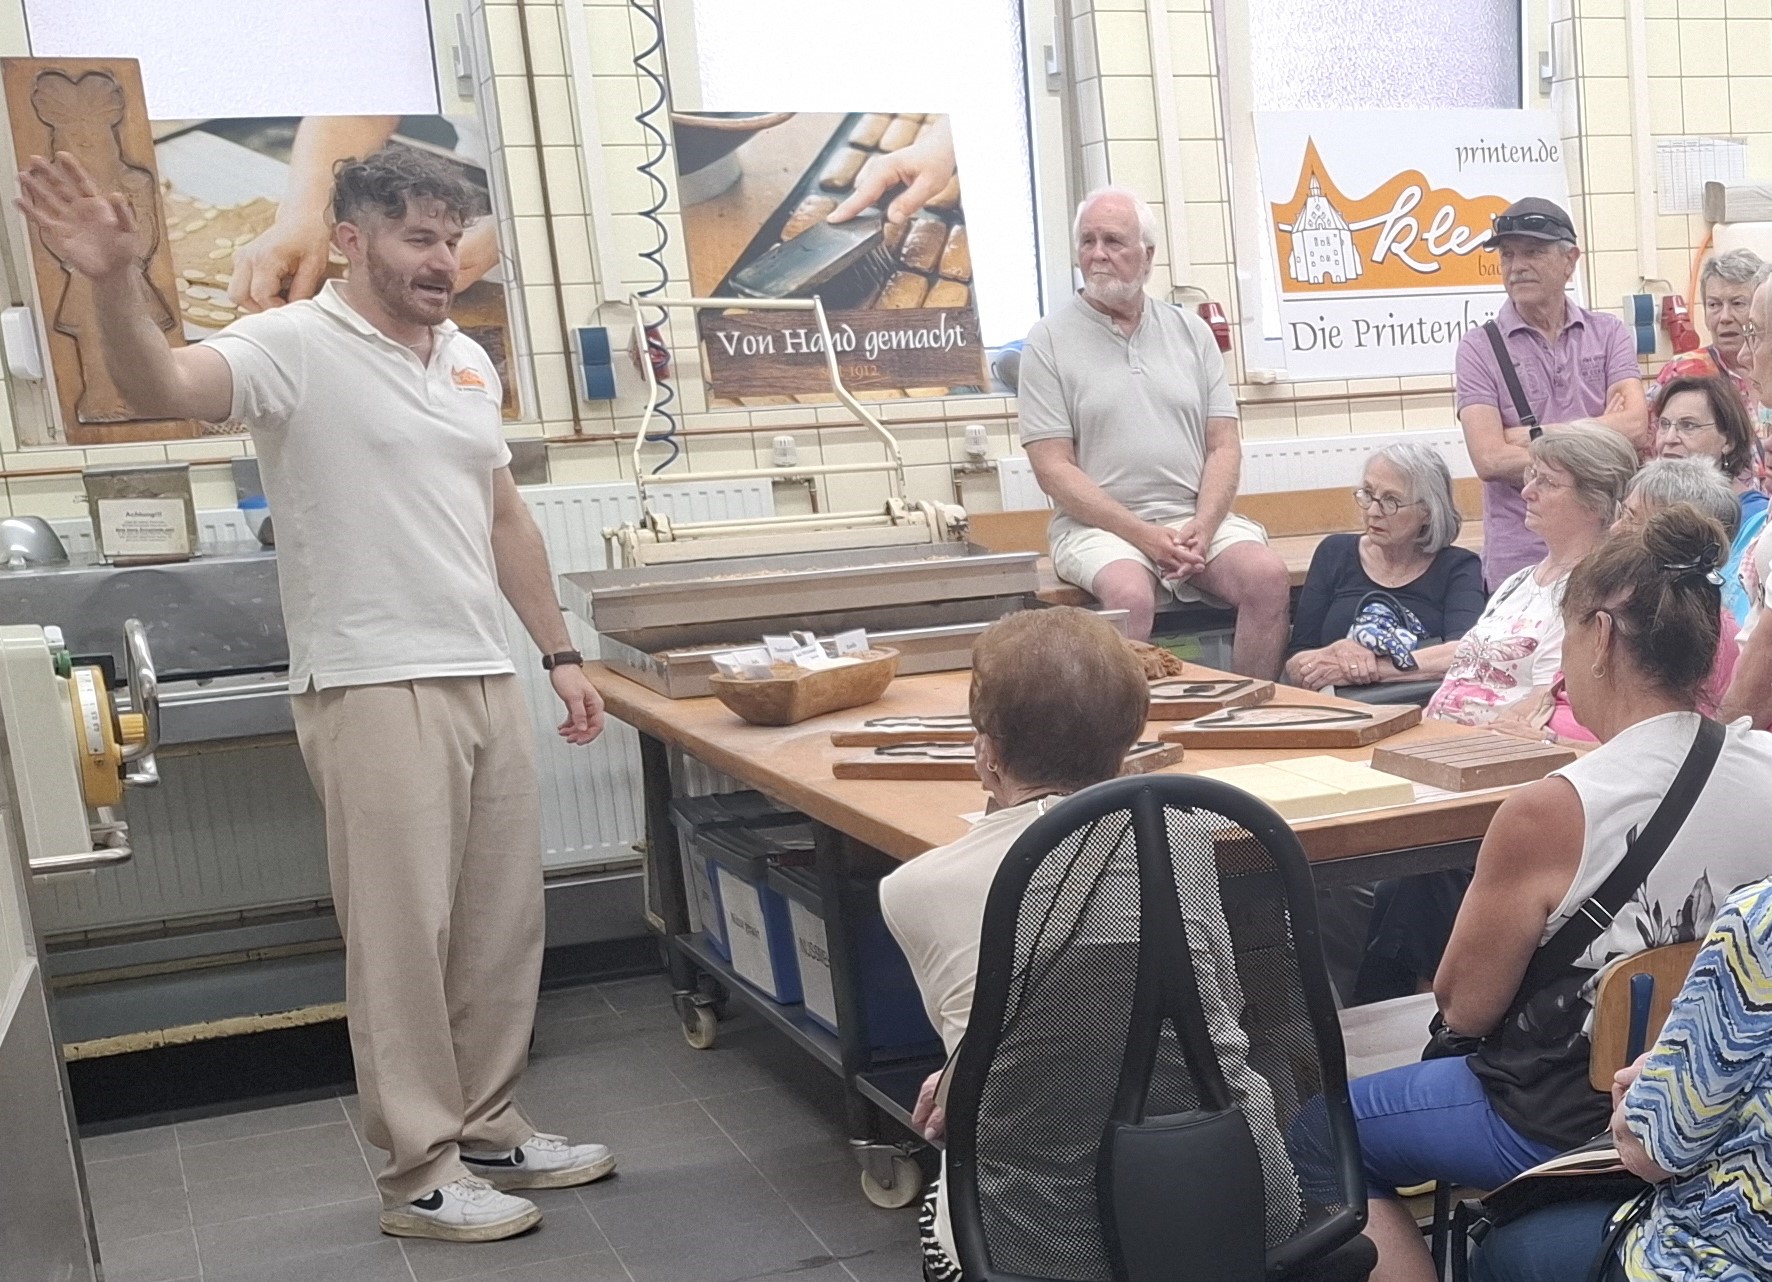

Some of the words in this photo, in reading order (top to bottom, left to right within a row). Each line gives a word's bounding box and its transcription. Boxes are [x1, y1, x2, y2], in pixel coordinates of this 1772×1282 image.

[1455, 138, 1560, 172] printen.de
[716, 330, 776, 357] Von
[864, 312, 967, 361] gemacht
[1288, 315, 1344, 352] Die
[850, 364, 881, 381] 1912
